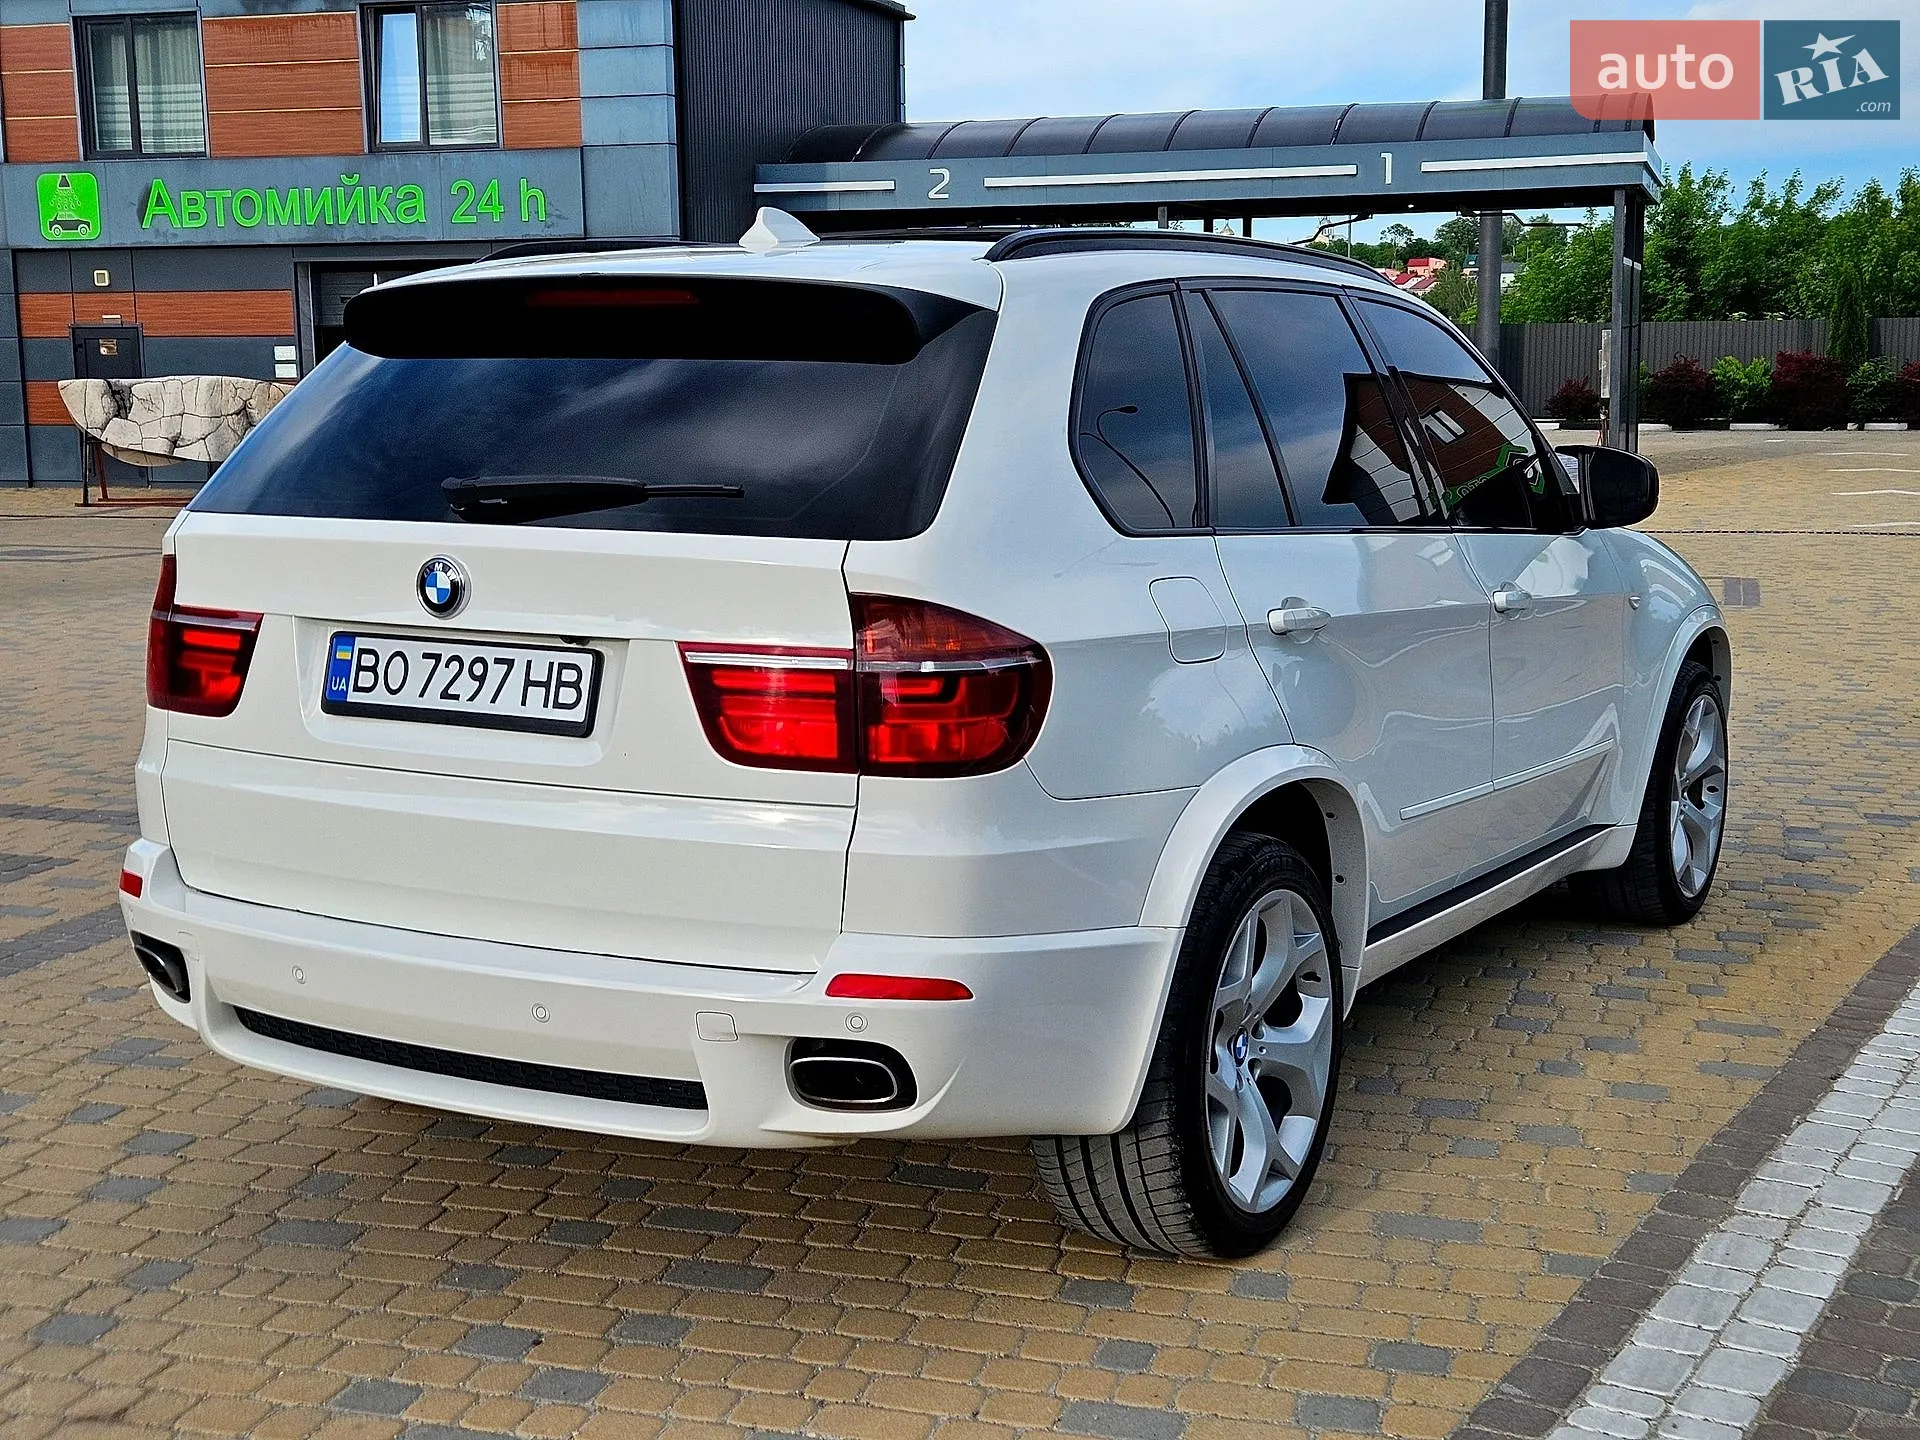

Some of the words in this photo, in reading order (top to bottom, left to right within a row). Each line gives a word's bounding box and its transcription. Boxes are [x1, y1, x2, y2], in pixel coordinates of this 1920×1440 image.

[928, 168, 950, 199] 2
[1380, 152, 1392, 184] 1
[141, 173, 427, 229] Автомийка
[450, 177, 505, 224] 24
[520, 177, 547, 223] h
[331, 676, 348, 692] UA
[352, 647, 410, 696] BO
[418, 652, 516, 705] 7297
[519, 659, 583, 711] HB
